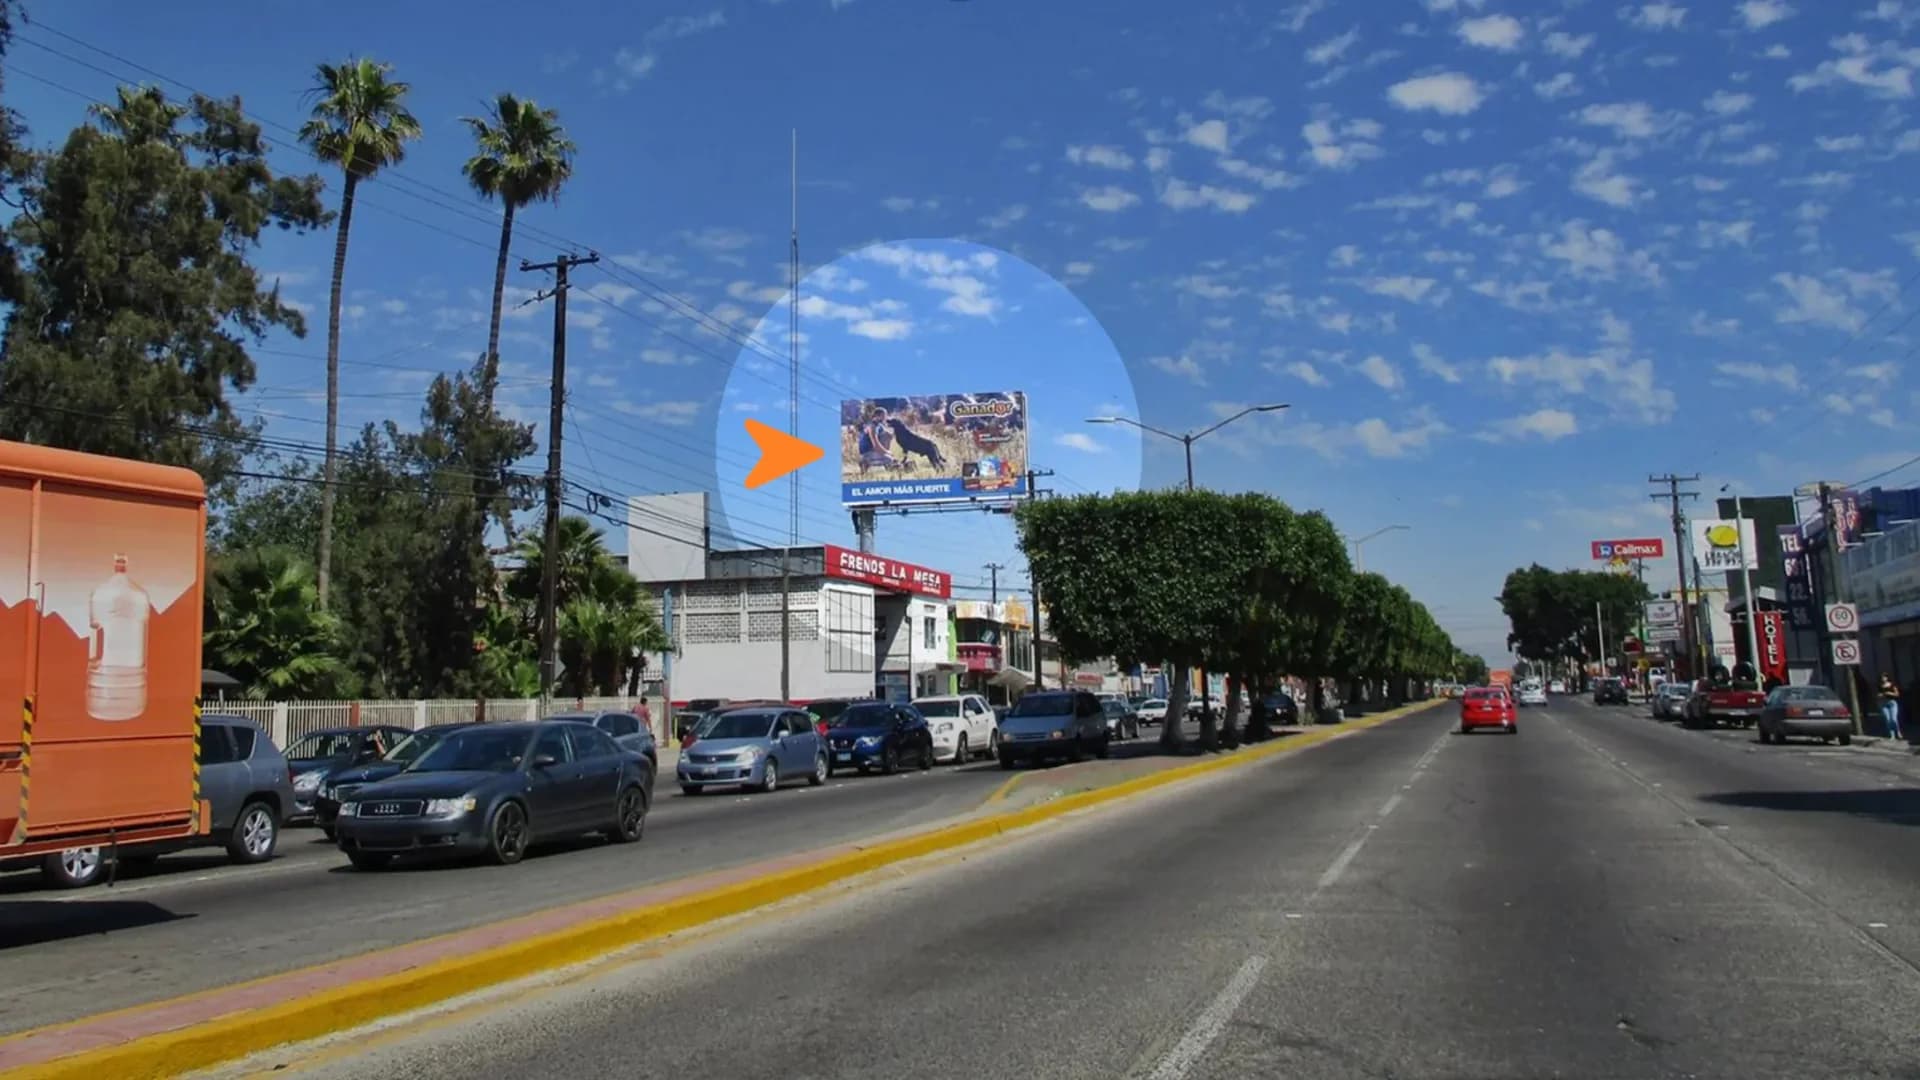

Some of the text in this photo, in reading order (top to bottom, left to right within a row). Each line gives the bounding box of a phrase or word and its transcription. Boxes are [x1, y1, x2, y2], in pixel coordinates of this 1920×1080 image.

[952, 400, 1013, 416] Ganador
[852, 483, 950, 496] EL AMOR MÁS FUERTE
[840, 552, 886, 575] FRENOS
[891, 565, 906, 579] LA
[913, 569, 941, 584] MESA
[1764, 613, 1779, 665] HOTEL
